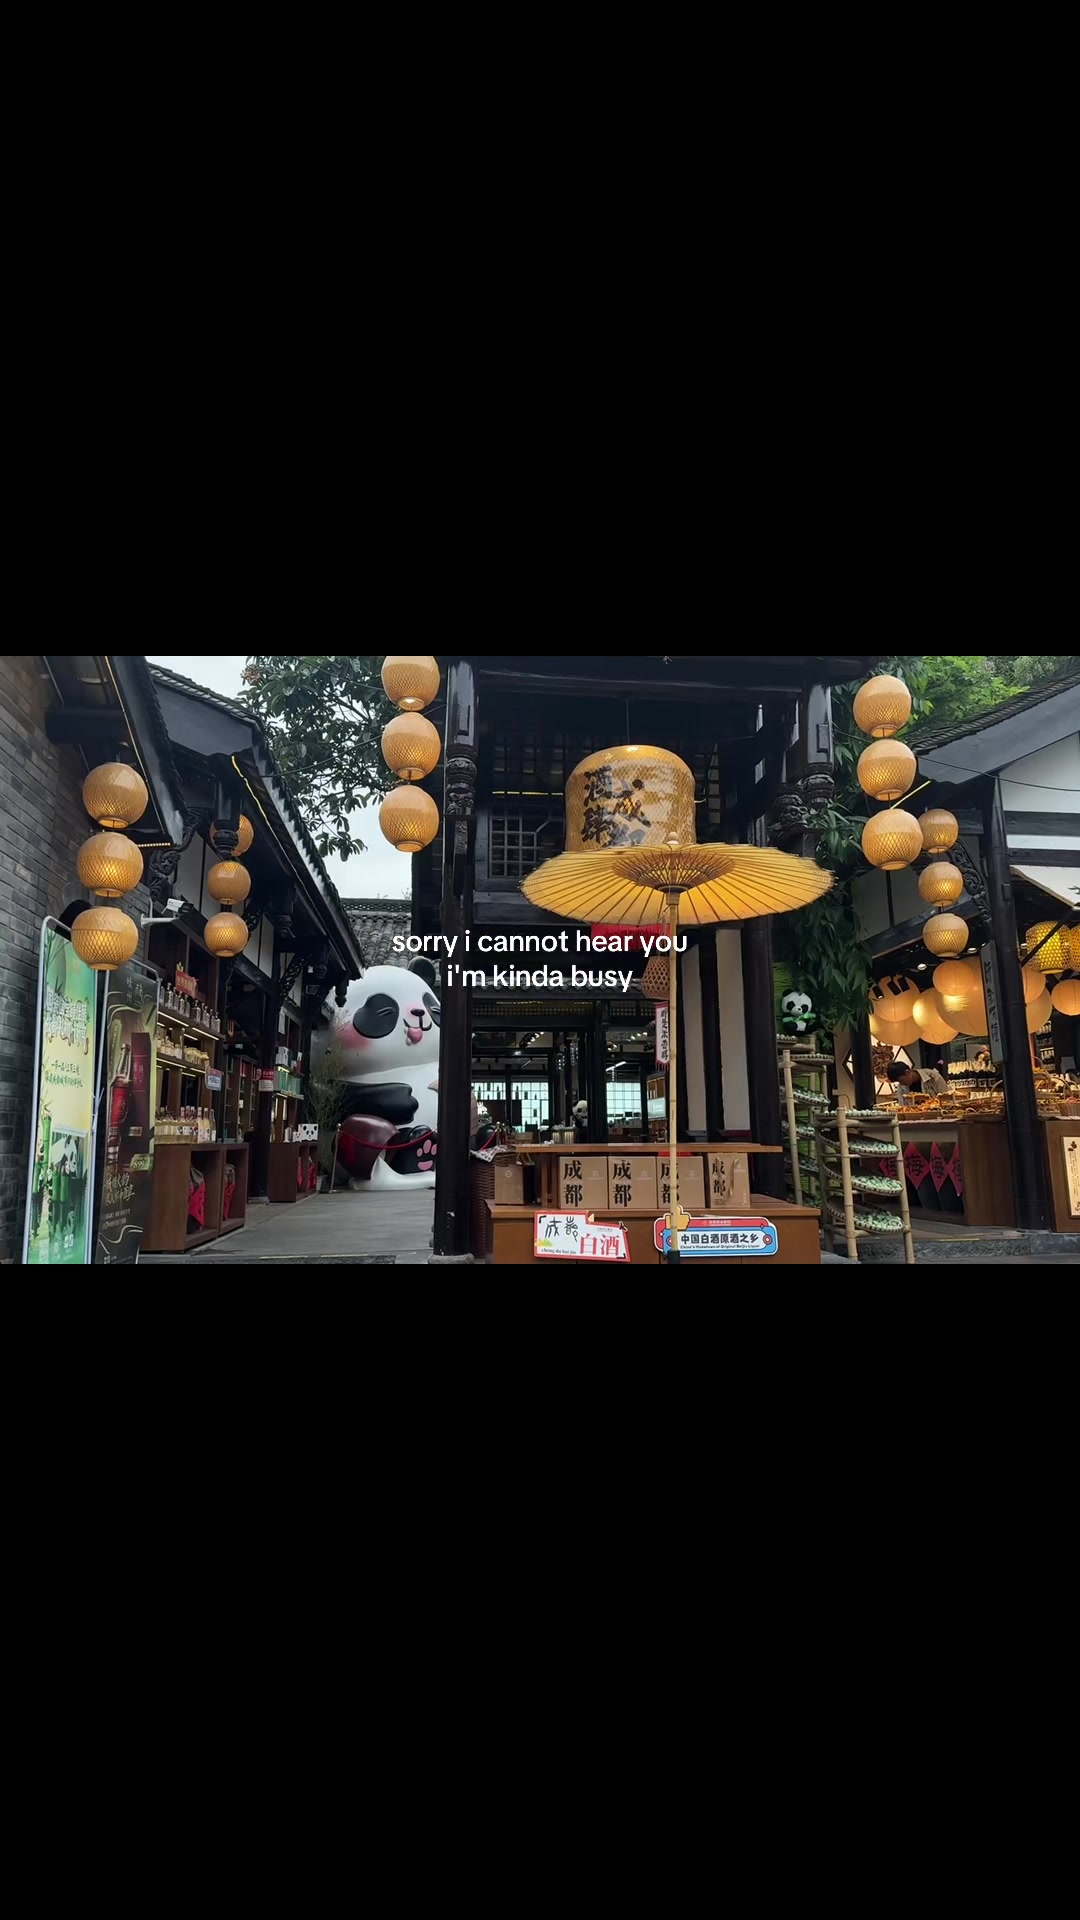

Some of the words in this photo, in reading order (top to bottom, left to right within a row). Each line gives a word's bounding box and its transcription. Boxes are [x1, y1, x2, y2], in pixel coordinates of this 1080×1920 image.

[563, 1160, 583, 1207] 成都
[613, 1159, 632, 1207] 成都
[580, 1233, 620, 1256] 白酒
[681, 1233, 759, 1244] 中国白酒原酒之乡
